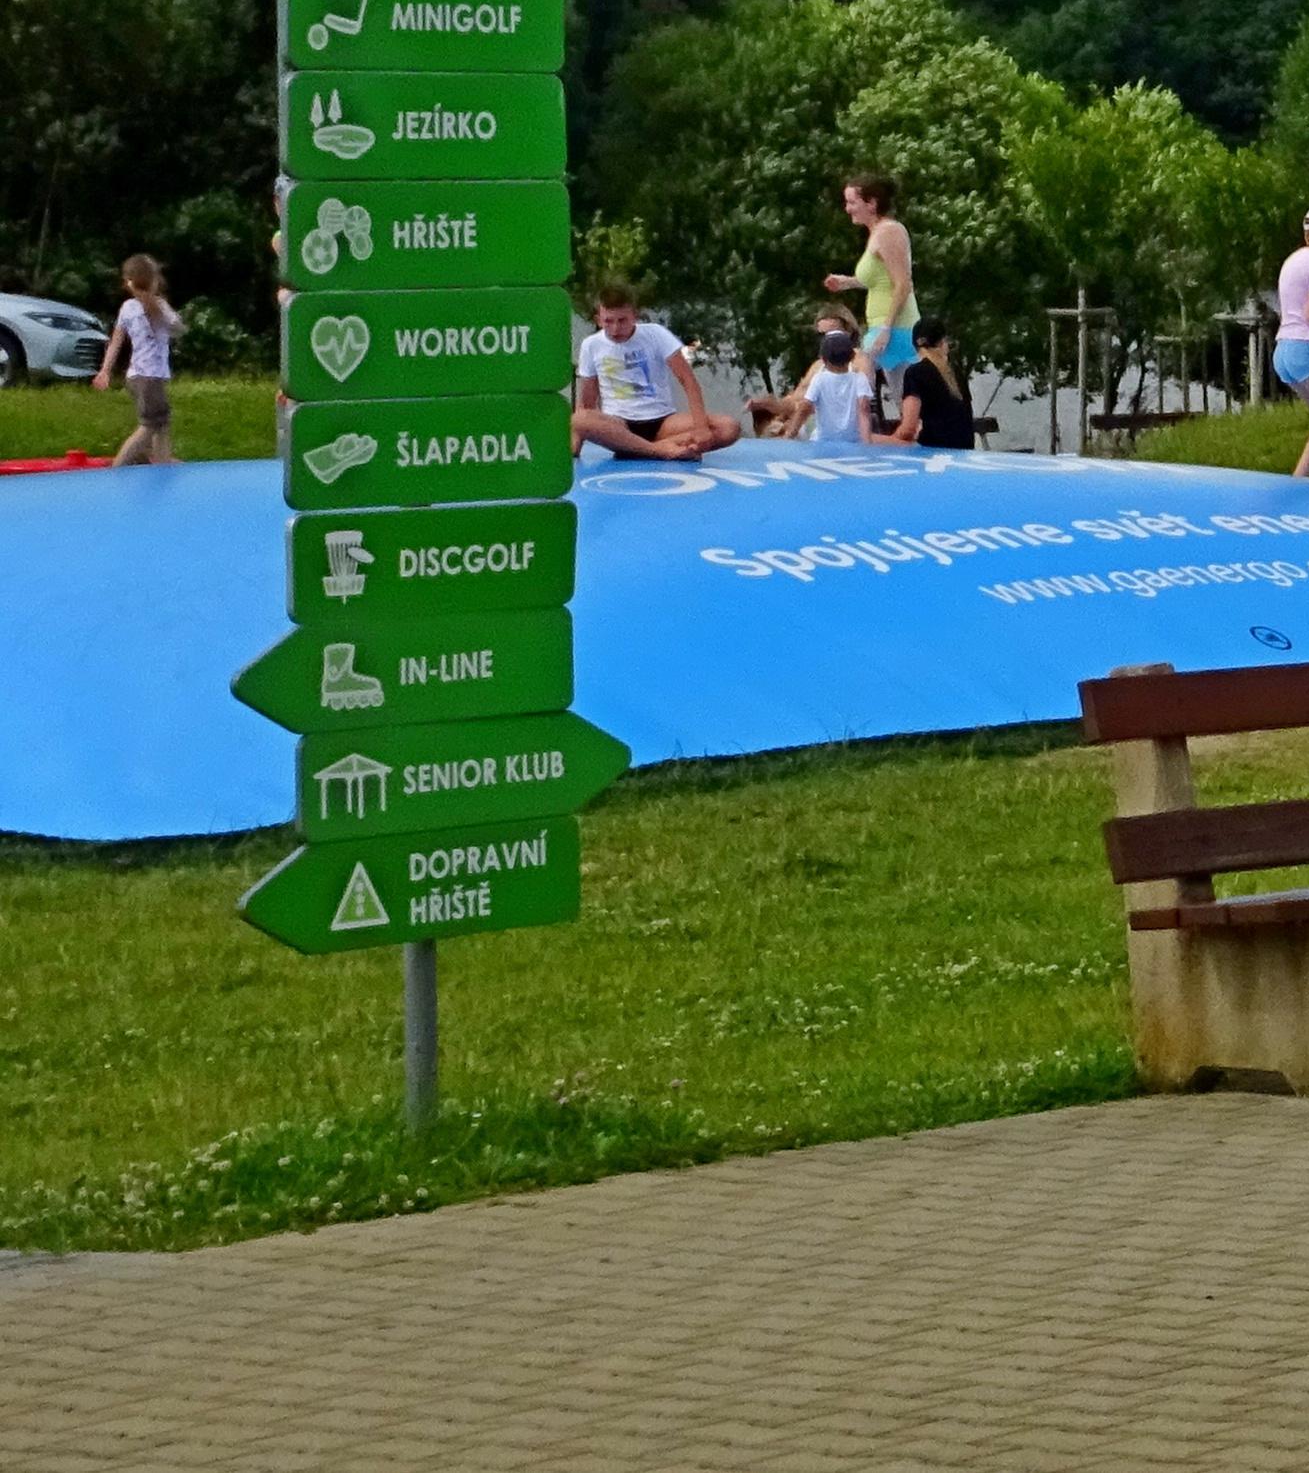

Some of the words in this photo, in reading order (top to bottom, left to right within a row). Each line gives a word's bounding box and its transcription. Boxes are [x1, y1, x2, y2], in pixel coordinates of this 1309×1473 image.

[391, 2, 522, 34] MINIGOLF
[392, 102, 497, 140] JEZÍRKO
[393, 213, 478, 249] HŘIŠTĚ
[394, 325, 531, 357] WORKOUT
[397, 431, 532, 467] ŠLAPADLA
[400, 541, 535, 578] DISCGOLF
[699, 523, 1074, 582] Spojujeme
[1071, 509, 1216, 541] svět
[400, 649, 494, 686] IN-LINE
[402, 757, 498, 795] SENIOR
[505, 750, 565, 784] KLUB
[408, 828, 548, 882] DOPRAVNÍ
[409, 880, 492, 925] HŘIŠTĚ
